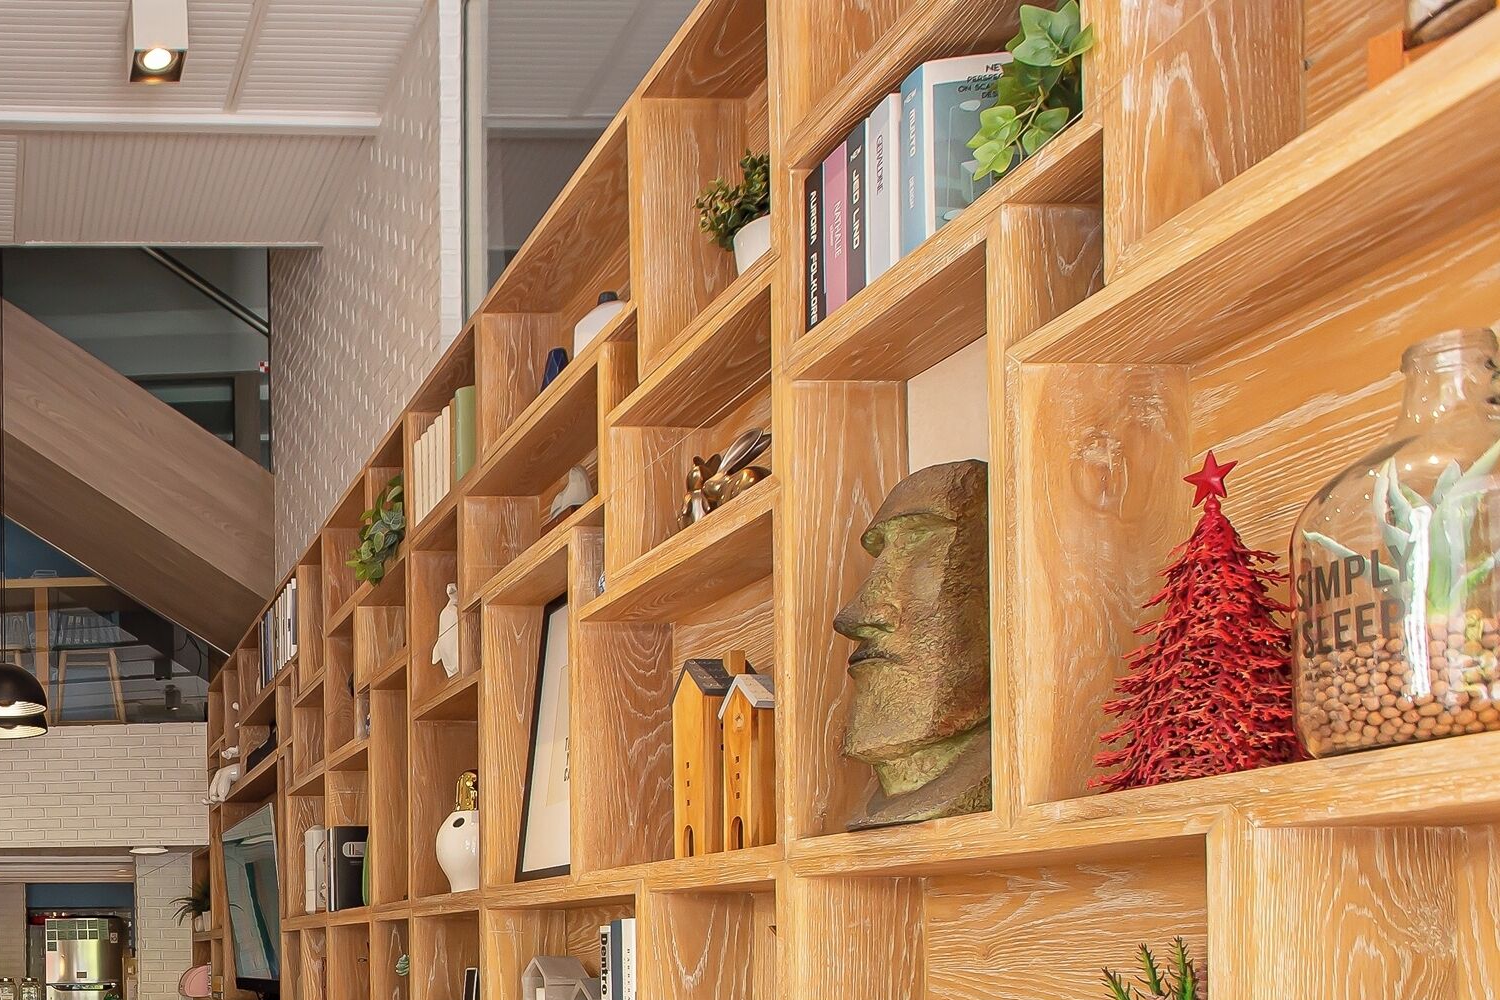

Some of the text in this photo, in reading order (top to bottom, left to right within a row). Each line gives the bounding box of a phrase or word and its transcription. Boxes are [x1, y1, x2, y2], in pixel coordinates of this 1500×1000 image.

[985, 63, 1003, 72] NE
[810, 190, 818, 326] AURORA FOLKLORE
[834, 200, 843, 259] NATHALIE
[852, 207, 860, 250] LIND
[1297, 540, 1417, 612] SIMPLY
[1302, 598, 1406, 660] SLEEP
[601, 933, 609, 995] Dentro
